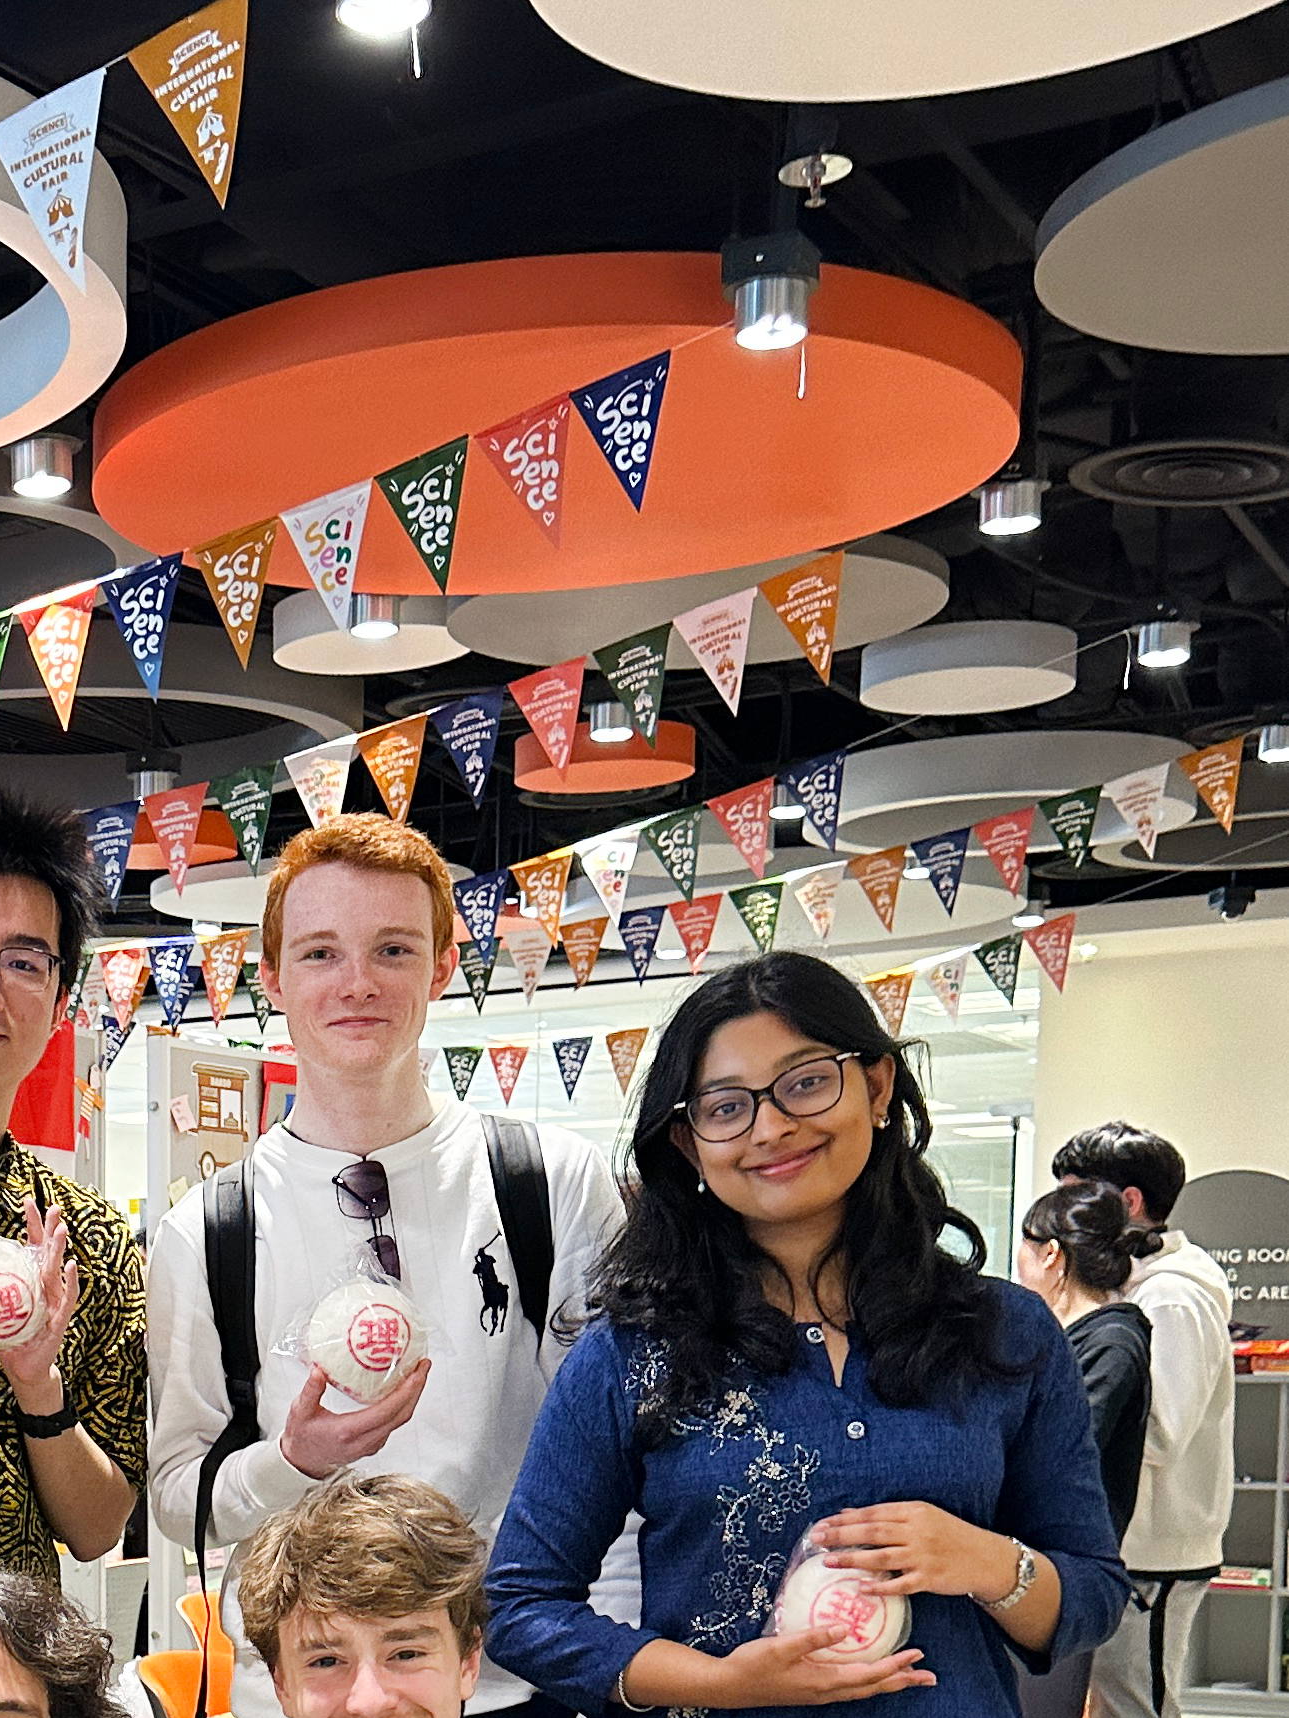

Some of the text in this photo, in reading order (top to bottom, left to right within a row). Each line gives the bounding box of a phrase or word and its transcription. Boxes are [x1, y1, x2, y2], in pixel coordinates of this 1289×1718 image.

[174, 35, 211, 60] SCIENCE
[155, 40, 240, 98] INTERNATIONAL
[170, 66, 233, 112] CULTURAL
[190, 88, 218, 112] FAIR
[30, 118, 67, 141] SCIENCE
[10, 127, 92, 173] INTERNATIONAL
[23, 151, 84, 188] CULTURAL
[42, 172, 68, 192] FAIR
[786, 599, 832, 622] CULTURAL
[699, 633, 742, 655] CULTURAL
[617, 670, 659, 690] CULTURAL
[358, 1318, 402, 1367] 理
